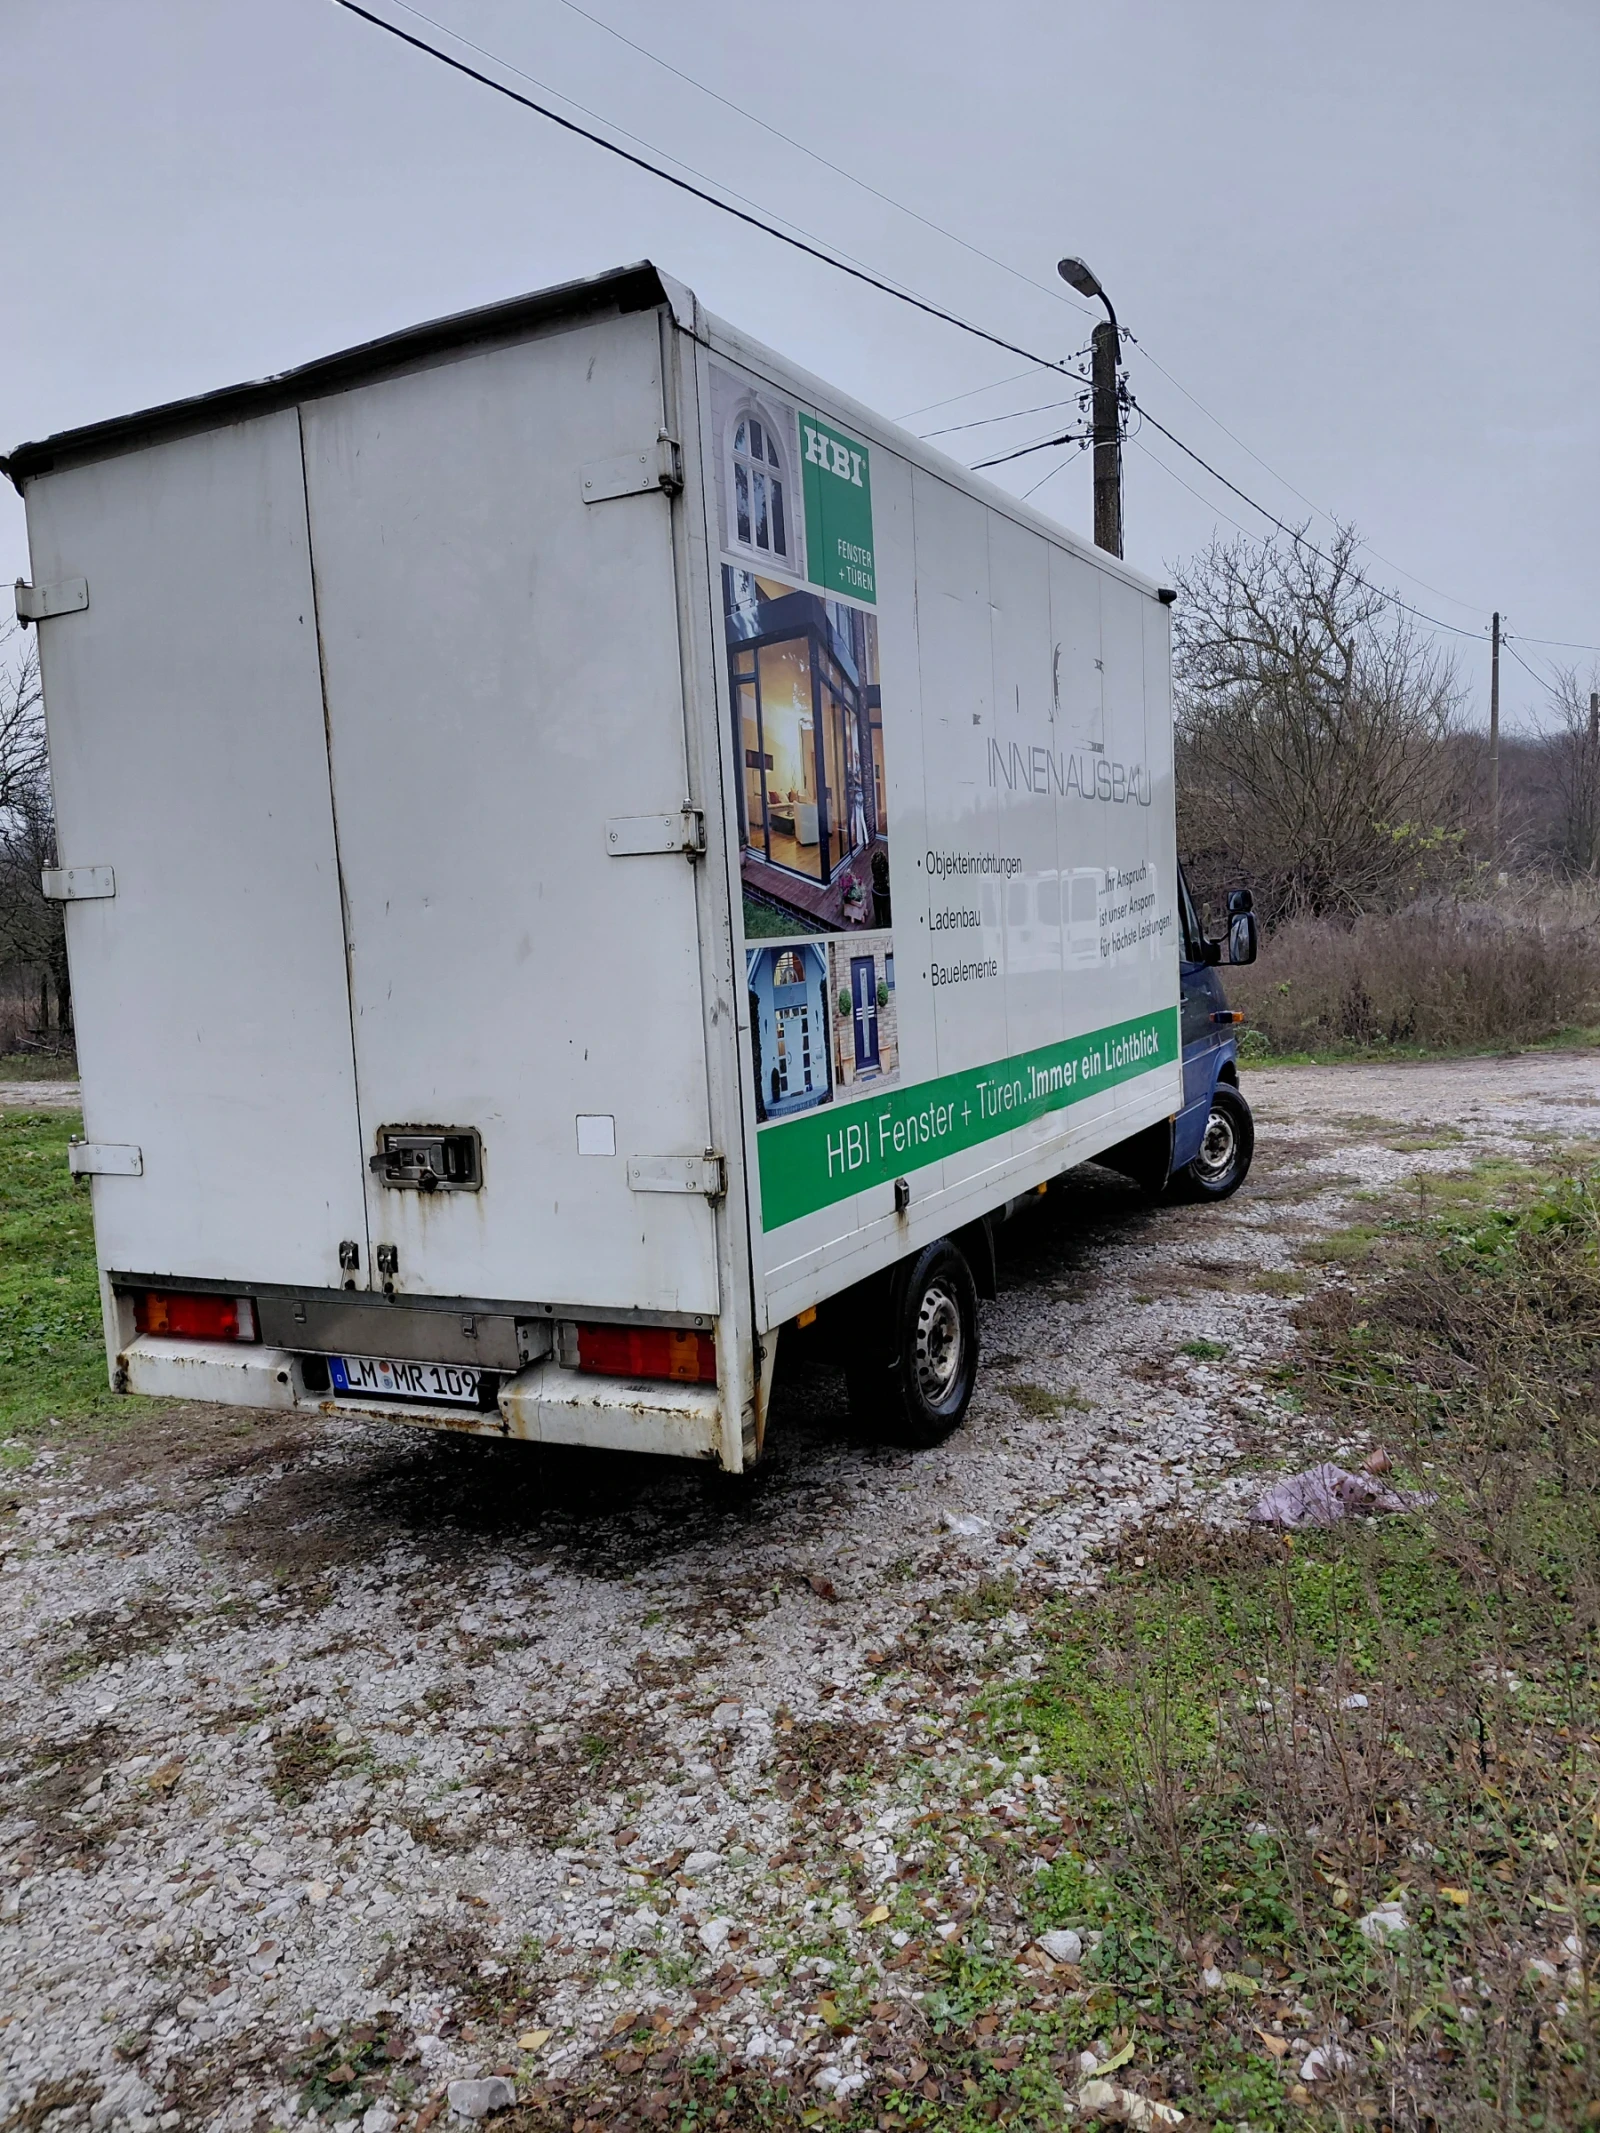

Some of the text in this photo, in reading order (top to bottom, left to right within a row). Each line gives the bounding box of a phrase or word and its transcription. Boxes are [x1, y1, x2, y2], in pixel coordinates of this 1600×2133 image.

[838, 538, 872, 568] FENSTER
[846, 565, 873, 592] TÜREN
[987, 737, 1152, 807] INNENAUSBAU
[926, 850, 1022, 880] Objekteinrichtungen
[1117, 859, 1147, 891] Anspruch
[928, 906, 981, 931] Ladenbau
[1099, 893, 1156, 928] ist unser Ansporn
[1100, 908, 1172, 958] für höchste Leistungen!
[931, 957, 998, 987] Bauelemente
[827, 1120, 870, 1178] HBI
[878, 1103, 955, 1158] Fenster
[1081, 1047, 1101, 1080] ein
[1105, 1026, 1160, 1072] Lichtblick
[343, 1359, 379, 1388] LM
[391, 1363, 428, 1393] MR
[430, 1367, 478, 1397] 109
